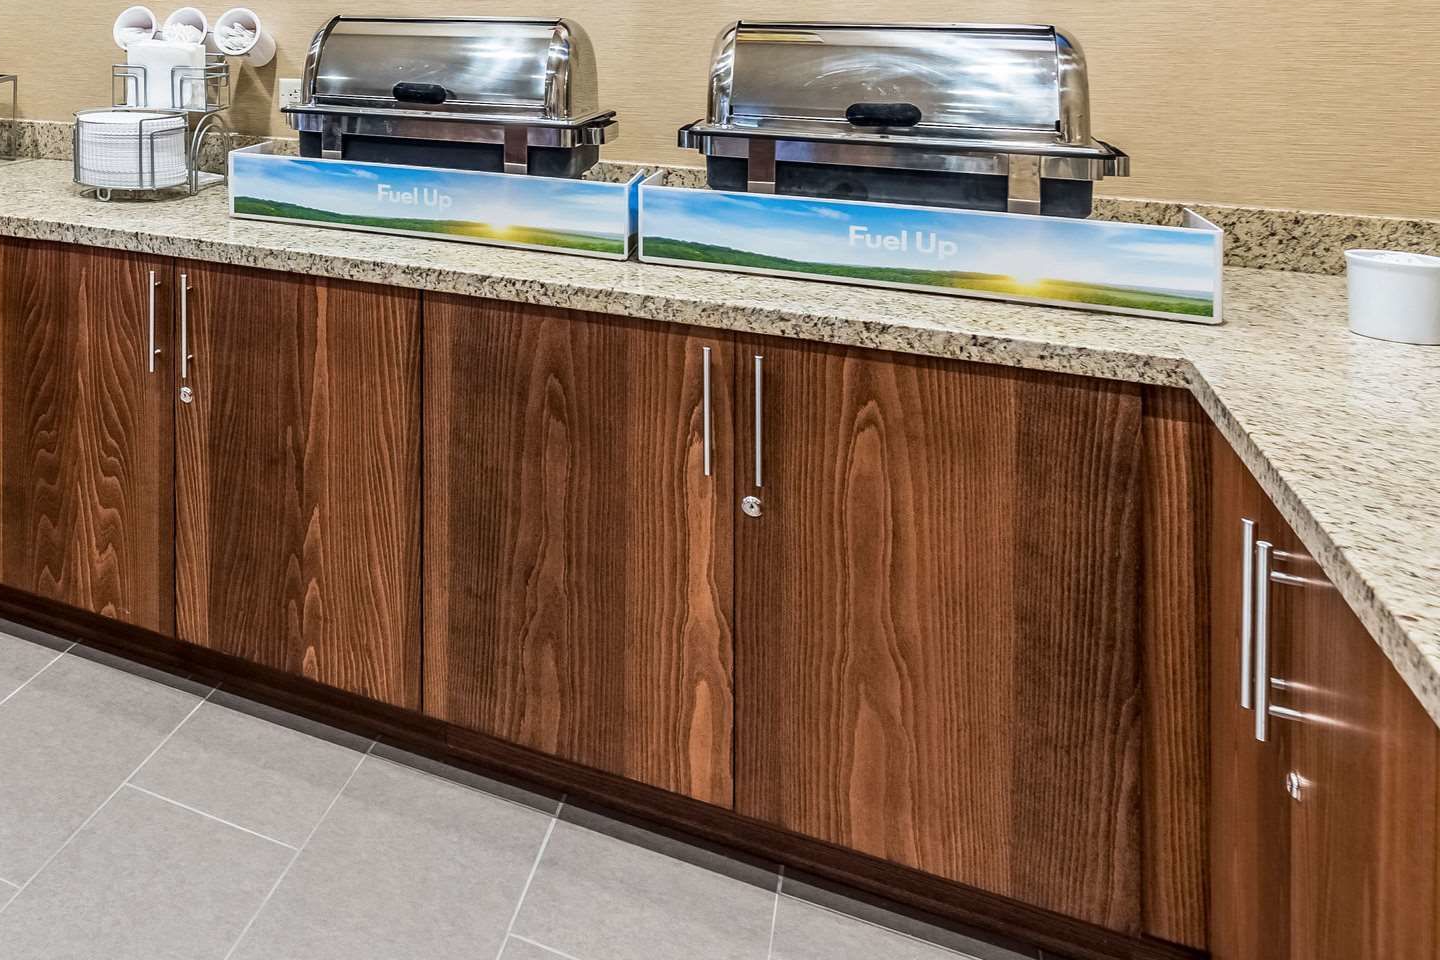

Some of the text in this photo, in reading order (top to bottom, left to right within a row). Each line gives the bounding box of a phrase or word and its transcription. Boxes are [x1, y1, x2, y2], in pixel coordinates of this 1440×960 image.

[377, 183, 453, 212] Fuel Up
[848, 224, 959, 261] Fuel Up
